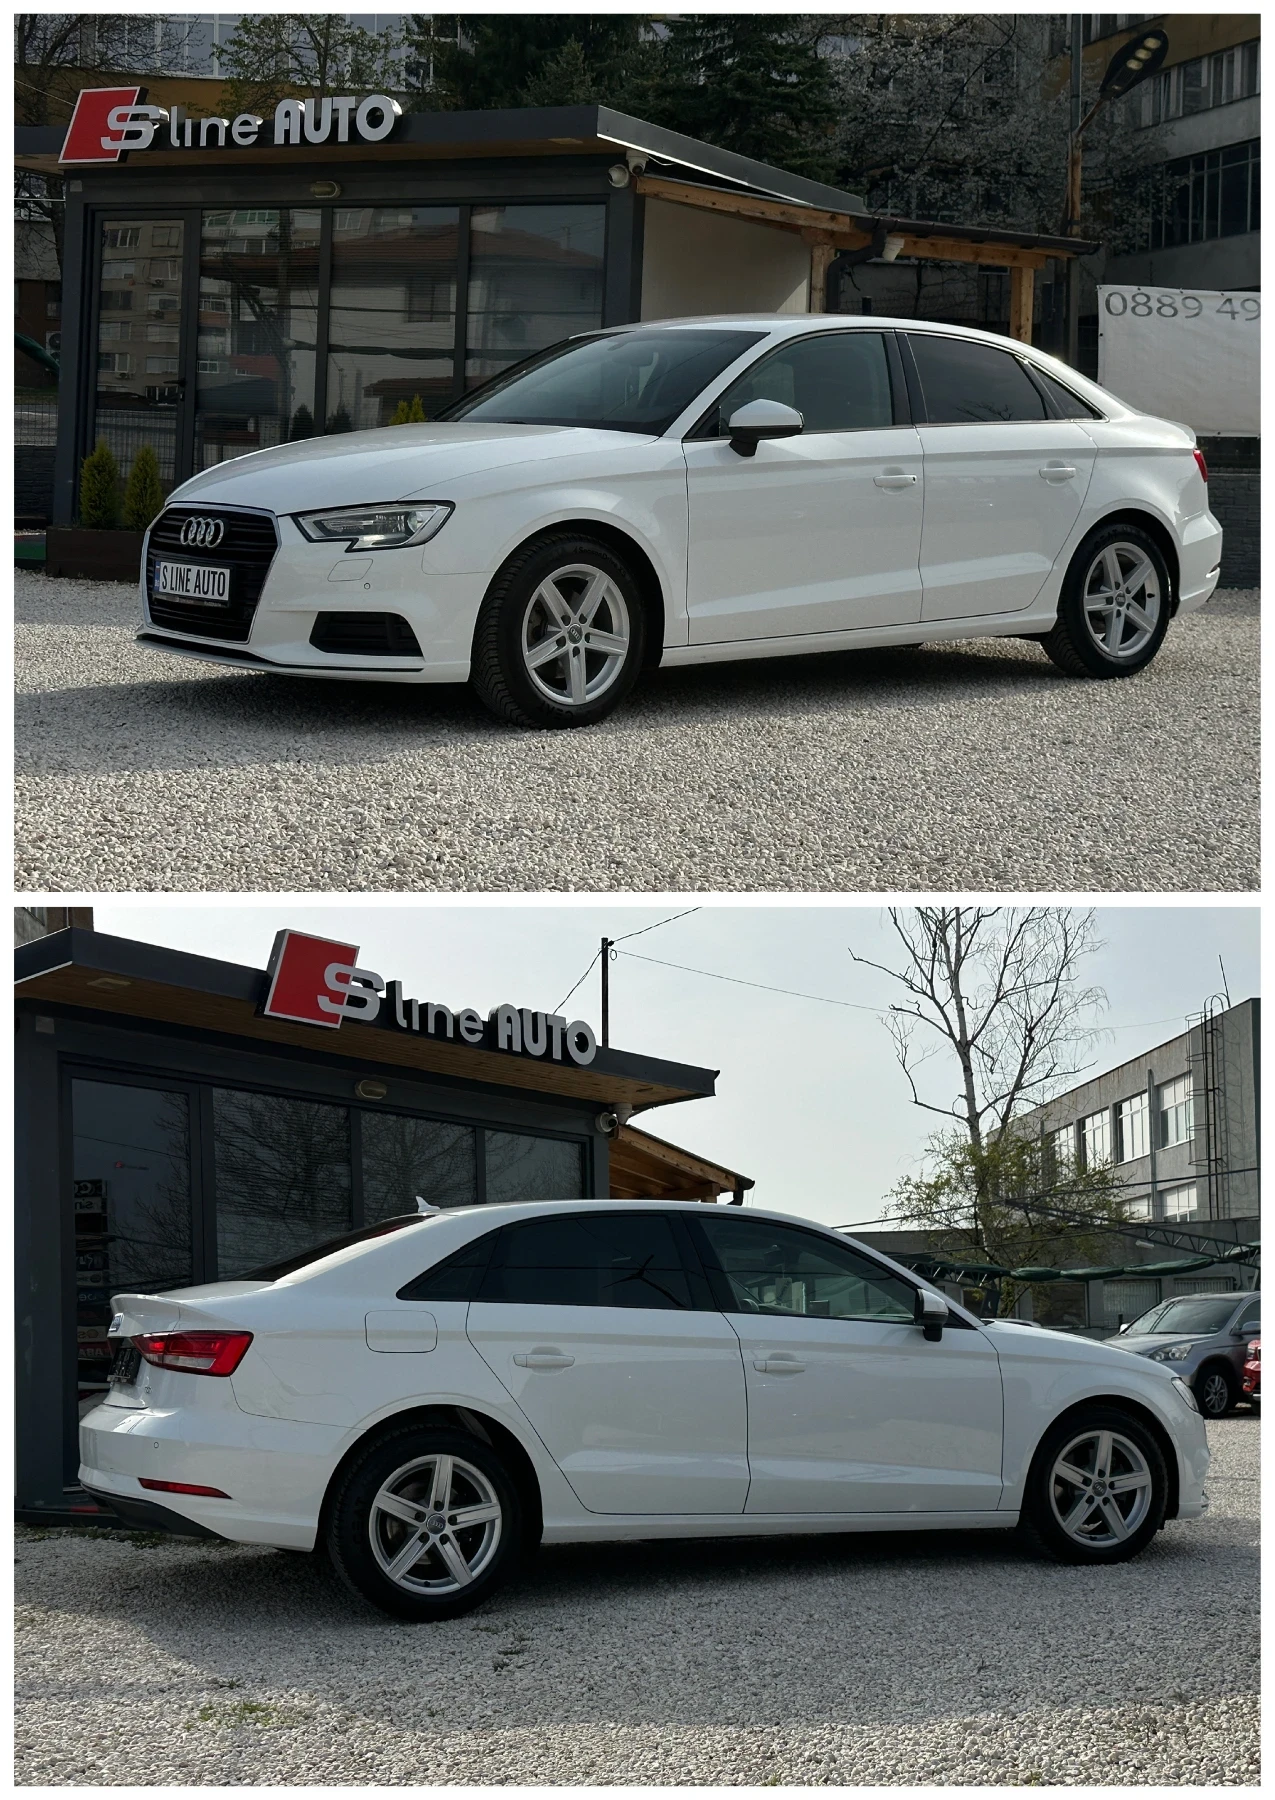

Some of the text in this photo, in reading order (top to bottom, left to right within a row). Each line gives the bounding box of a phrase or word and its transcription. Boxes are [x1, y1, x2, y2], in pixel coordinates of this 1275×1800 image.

[101, 94, 401, 150] S line AUTO
[1105, 292, 1261, 321] 0889 49
[162, 564, 226, 597] S LINE AUTO
[317, 962, 597, 1066] S line AUTO
